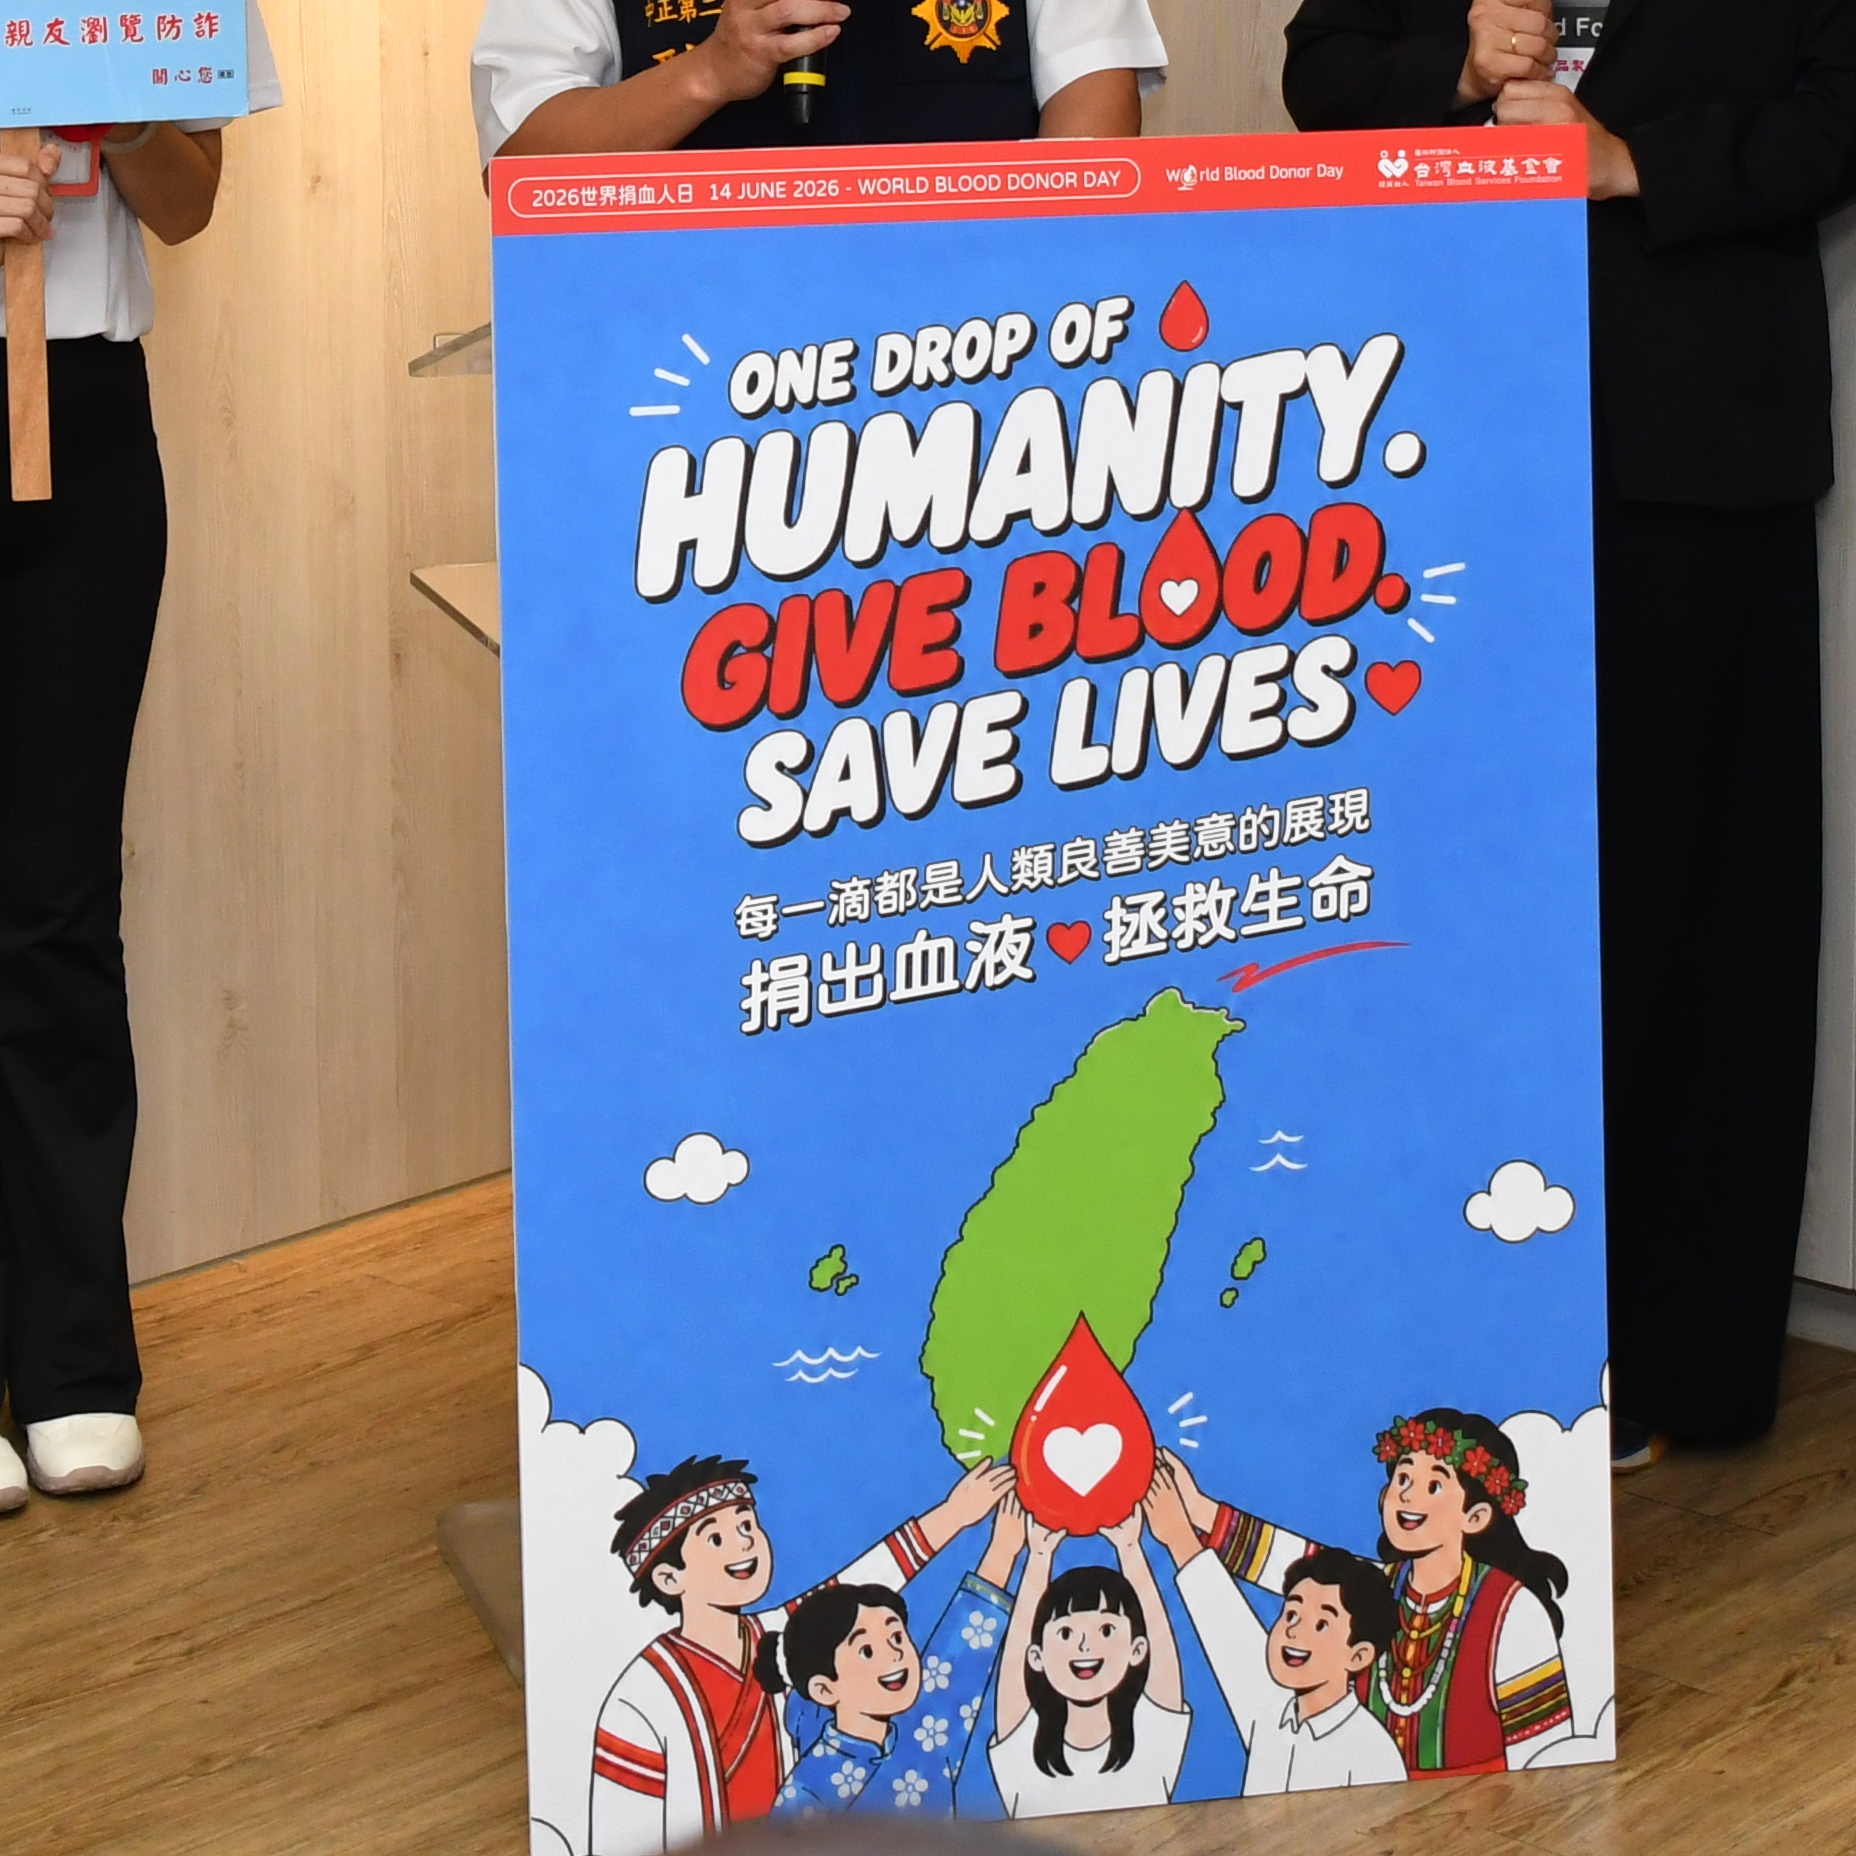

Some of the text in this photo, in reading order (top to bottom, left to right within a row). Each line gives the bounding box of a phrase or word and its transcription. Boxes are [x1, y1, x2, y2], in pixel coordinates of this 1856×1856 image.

[153, 67, 213, 85] 關心您
[531, 183, 694, 209] 2026世界捐血人日
[709, 183, 732, 202] 14
[737, 181, 787, 200] JUNE
[793, 178, 841, 198] 2026
[857, 176, 930, 196] WORLD
[935, 174, 1002, 194] BLOOD
[1007, 170, 1078, 191] DONOR
[1082, 170, 1122, 189] DAY
[1225, 165, 1266, 183] Blood
[1270, 163, 1313, 181] Donor
[1316, 162, 1344, 181] Day
[1414, 157, 1562, 179] 台灣血液基金會
[1415, 179, 1443, 187] Taiwan
[1447, 178, 1472, 186] Blood
[1475, 177, 1511, 185] Services
[1514, 175, 1562, 183] Foundation
[728, 295, 1133, 420] ONE DROP OF
[634, 332, 1427, 603] HUMANITY.
[681, 502, 1411, 731] GIVE BLOOD.
[738, 635, 1358, 849] SAVE LIVES
[733, 787, 1371, 943] 每一滴都是人類良善美意的展現
[740, 853, 1374, 1035] 捐出血液 拯救生命
